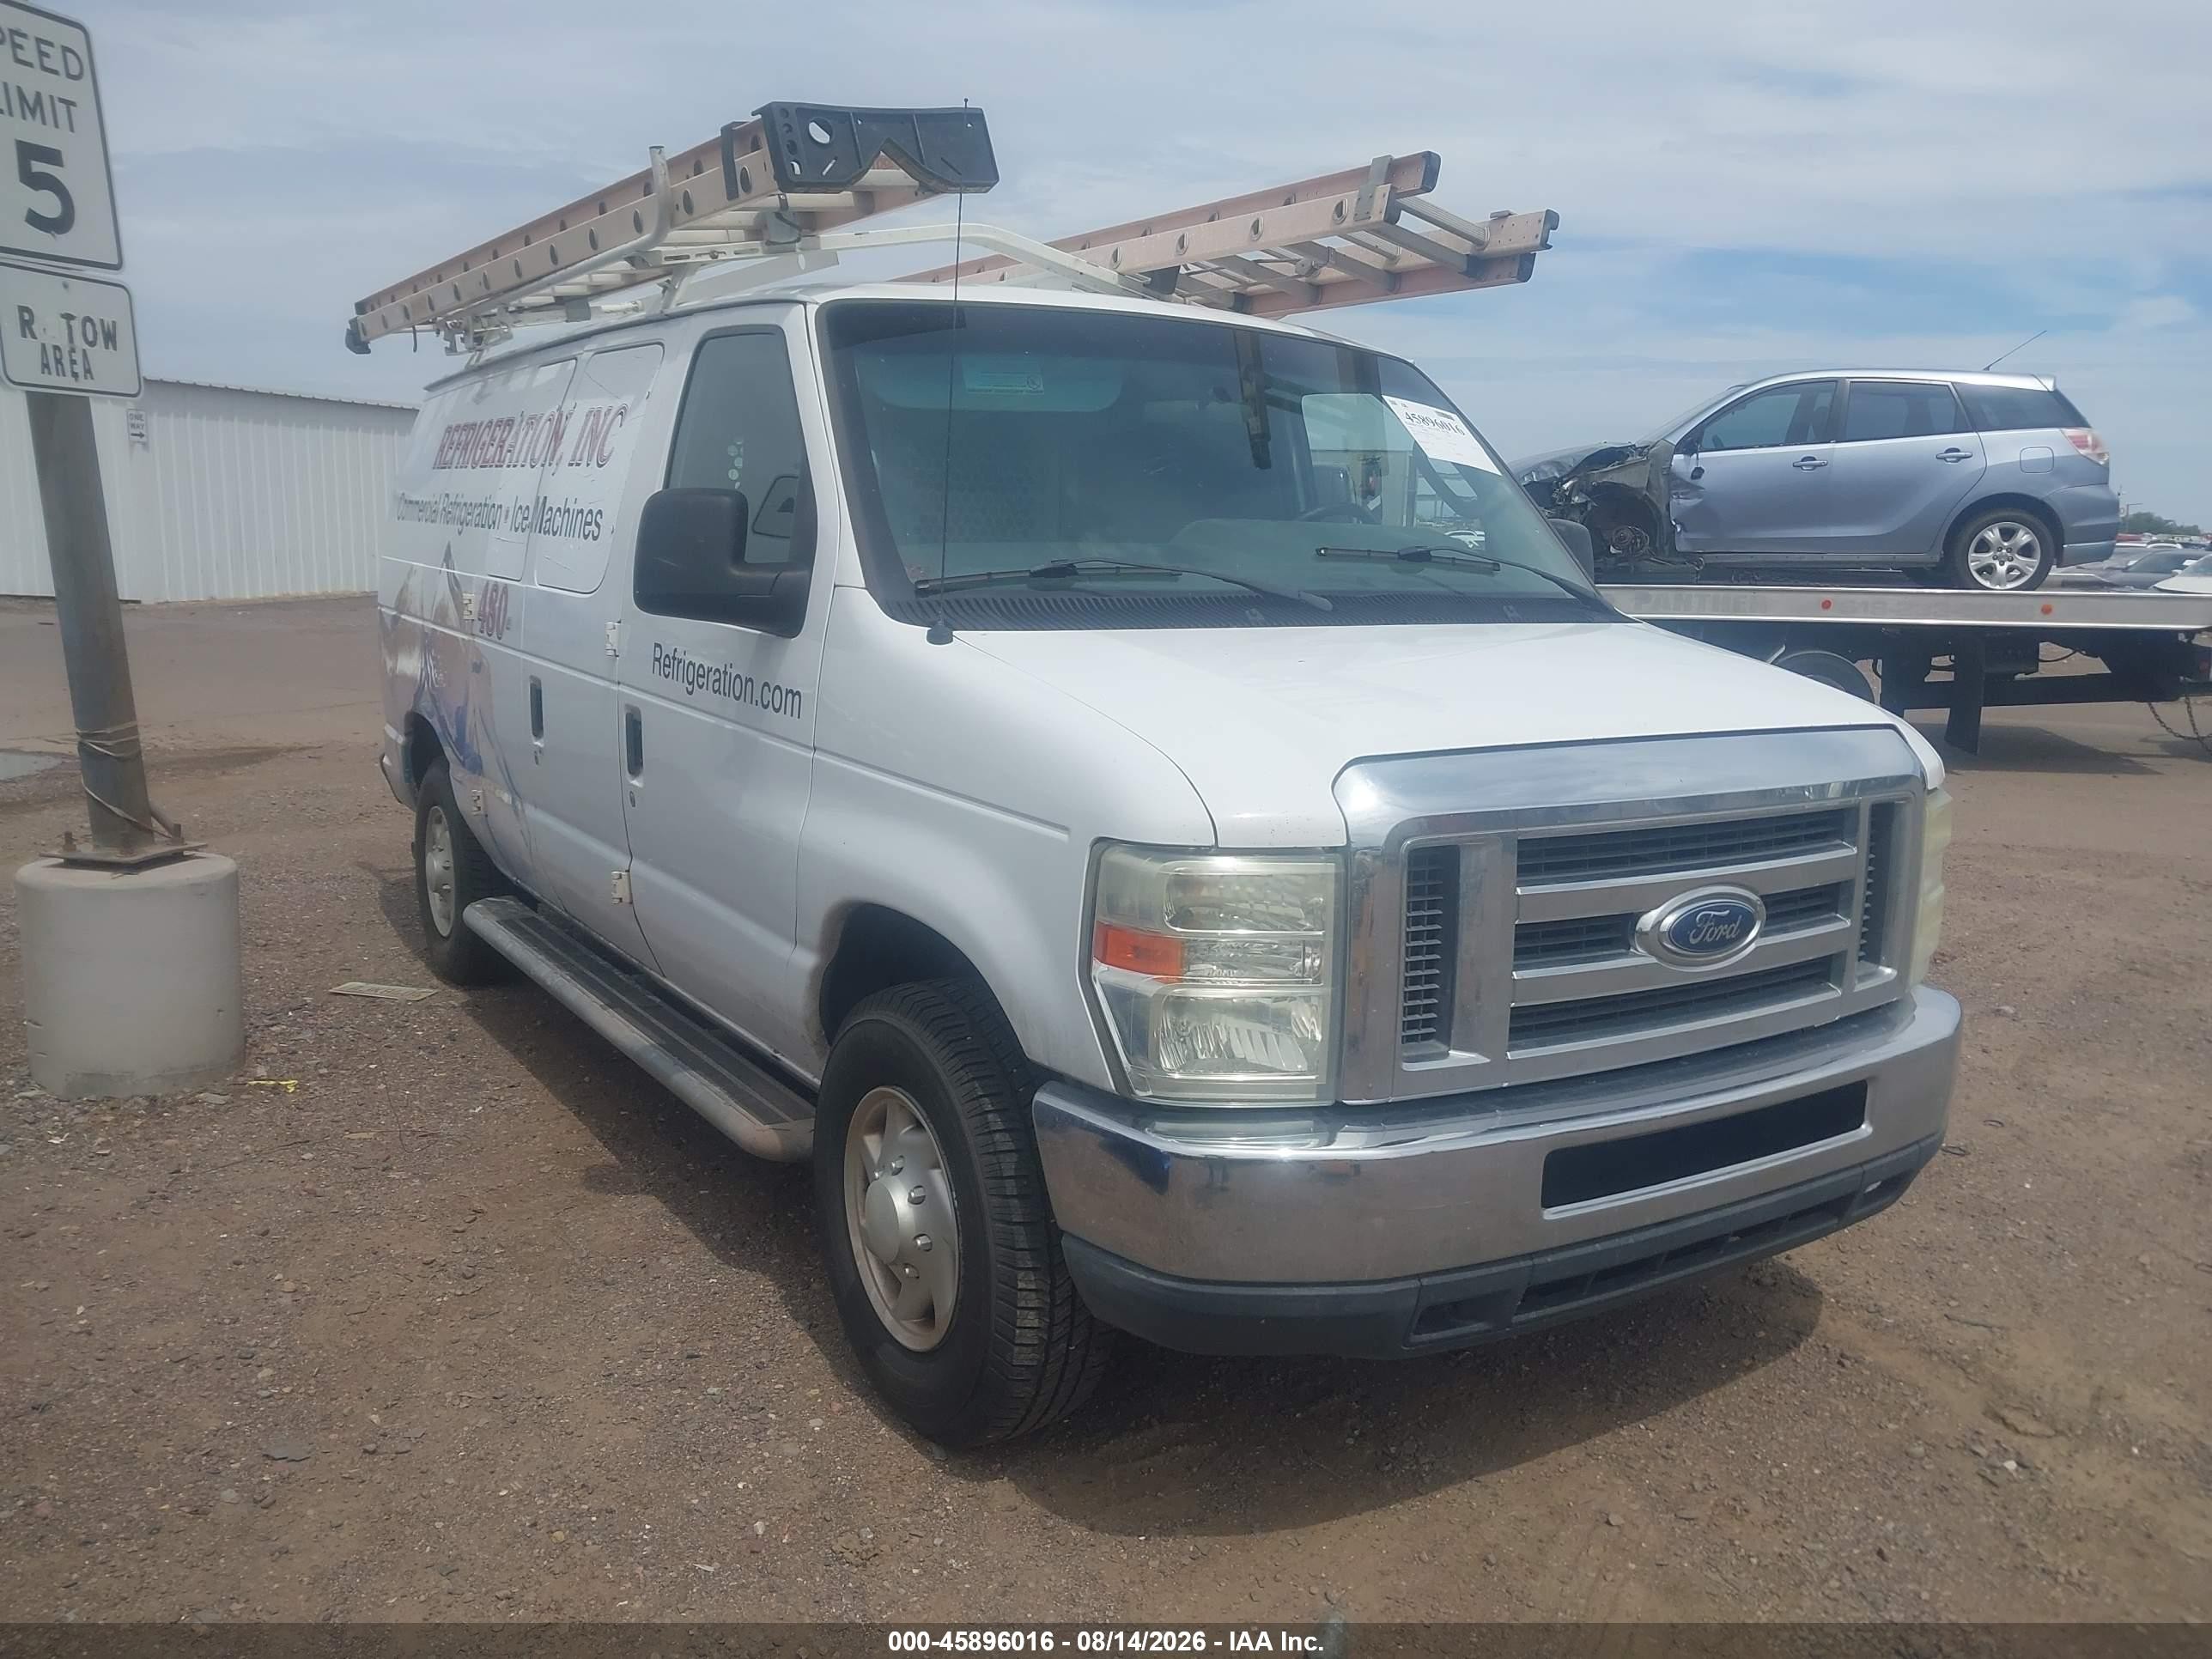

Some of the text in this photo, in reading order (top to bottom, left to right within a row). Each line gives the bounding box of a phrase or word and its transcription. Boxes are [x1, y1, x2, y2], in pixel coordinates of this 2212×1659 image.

[15, 138, 76, 235] 5
[59, 312, 118, 351] TOW
[40, 343, 95, 382] AREA
[568, 403, 629, 469] INC
[1404, 412, 1466, 435] 45896016
[439, 493, 502, 536] Refrigeration
[509, 495, 530, 533] Ice
[529, 495, 603, 541] Machines
[652, 642, 802, 720] Refrigeration.com
[1689, 909, 1742, 945] Ford
